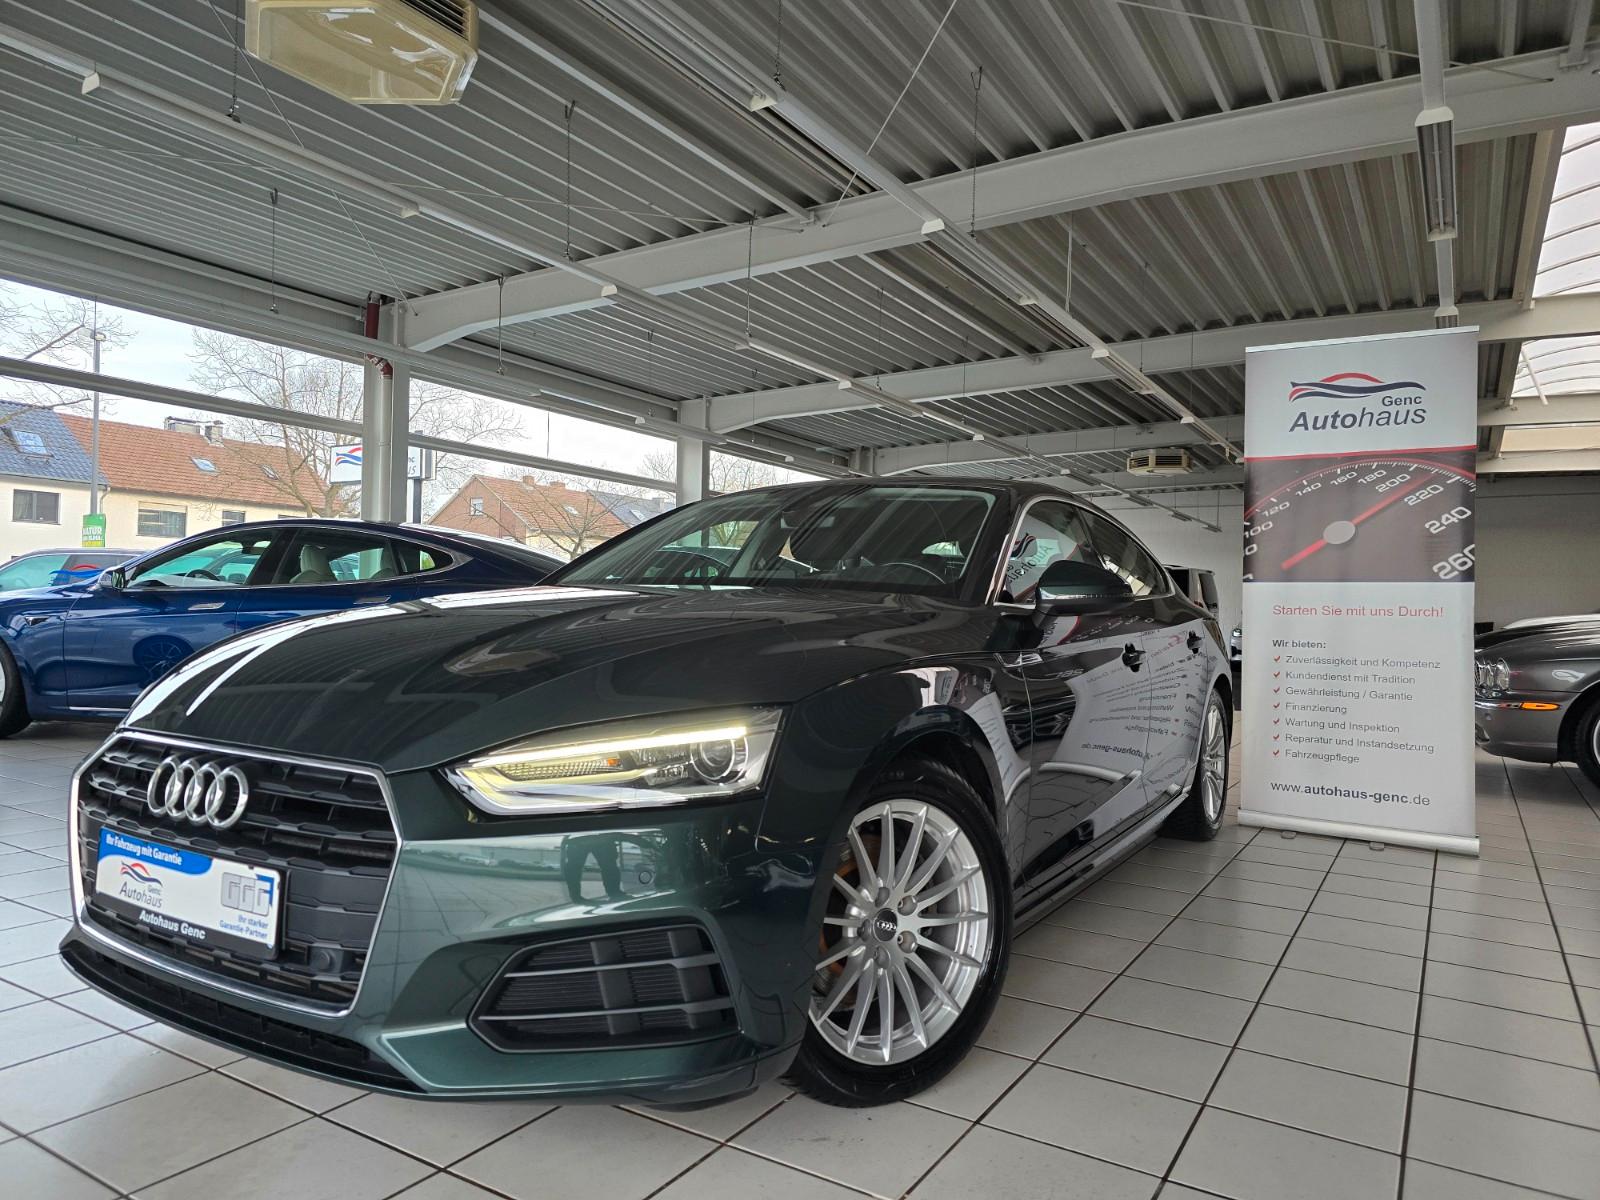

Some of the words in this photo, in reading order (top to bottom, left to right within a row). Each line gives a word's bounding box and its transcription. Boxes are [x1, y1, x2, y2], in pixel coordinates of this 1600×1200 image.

[1381, 394, 1422, 406] Genc
[1289, 407, 1427, 432] Autohaus
[1330, 471, 1357, 486] 160
[1357, 469, 1387, 485] 180
[1375, 473, 1411, 493] 200
[1295, 482, 1322, 496] 140
[1404, 484, 1444, 506] 220
[1262, 501, 1290, 516] 120
[1425, 506, 1472, 535] 240
[1244, 521, 1273, 538] 100
[1272, 605, 1317, 616] Starten
[1321, 605, 1342, 616] Sie
[1346, 606, 1366, 616] mit
[1370, 608, 1394, 617] uns
[1398, 606, 1443, 618] Durch!
[1272, 639, 1288, 648] Wir
[1292, 640, 1327, 649] bieten:
[1285, 655, 1358, 667] Zuverlässigkeit
[1360, 657, 1379, 666] und
[1381, 658, 1441, 670] Kompetenz
[1285, 671, 1352, 682] Kundendienst
[1354, 673, 1369, 682] mit
[1372, 674, 1416, 684] Tradition
[1285, 687, 1360, 699] Gewährleistung
[1369, 690, 1413, 701] Garantie
[1285, 702, 1347, 714] Finanzierung
[1285, 718, 1325, 729] Wartung
[1327, 721, 1346, 730] und
[1349, 722, 1400, 733] Inspektion
[1285, 733, 1333, 745] Reparatur
[1335, 737, 1354, 746] und
[1357, 739, 1434, 754] Instandsetzung
[1285, 749, 1360, 764] Fahrzeugpflege
[1270, 782, 1431, 806] www.autohaus-genc.de
[105, 834, 114, 845] Ihr
[114, 836, 141, 856] Fahrzeug
[142, 846, 153, 857] mit
[153, 848, 183, 865] Garantie
[119, 881, 163, 909] Autohaus
[139, 909, 179, 932] Autohaus
[181, 922, 206, 940] Genc
